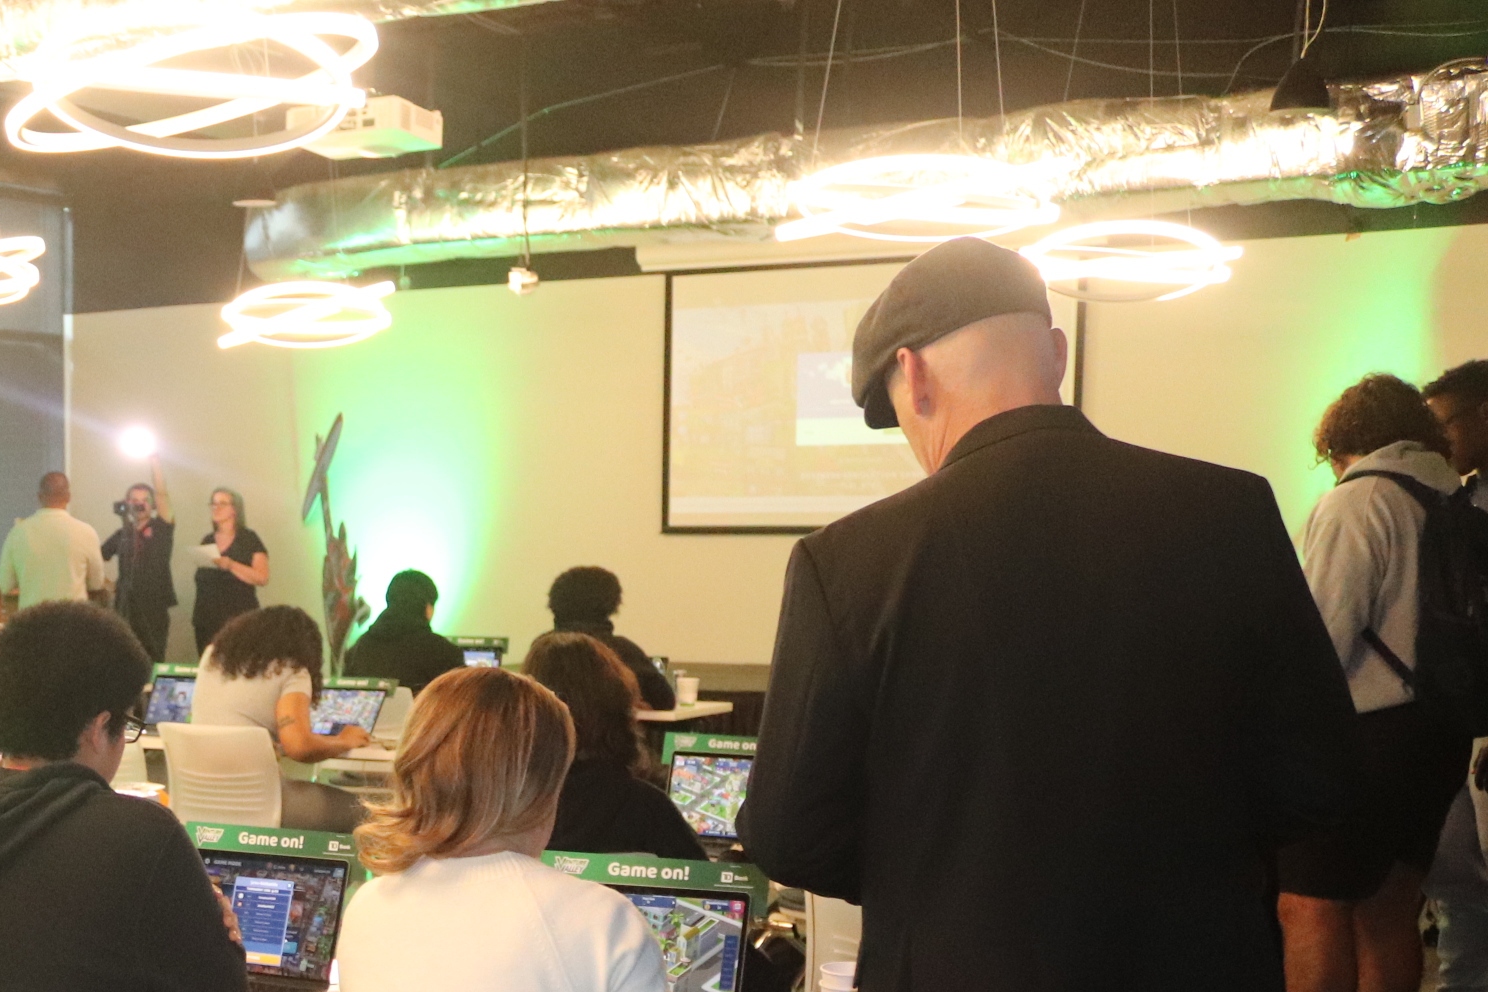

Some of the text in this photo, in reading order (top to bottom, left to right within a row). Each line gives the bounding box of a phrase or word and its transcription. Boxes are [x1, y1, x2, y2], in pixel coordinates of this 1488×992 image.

[708, 738, 757, 750] Game on
[238, 831, 305, 849] Game on!
[607, 862, 690, 881] Game on!
